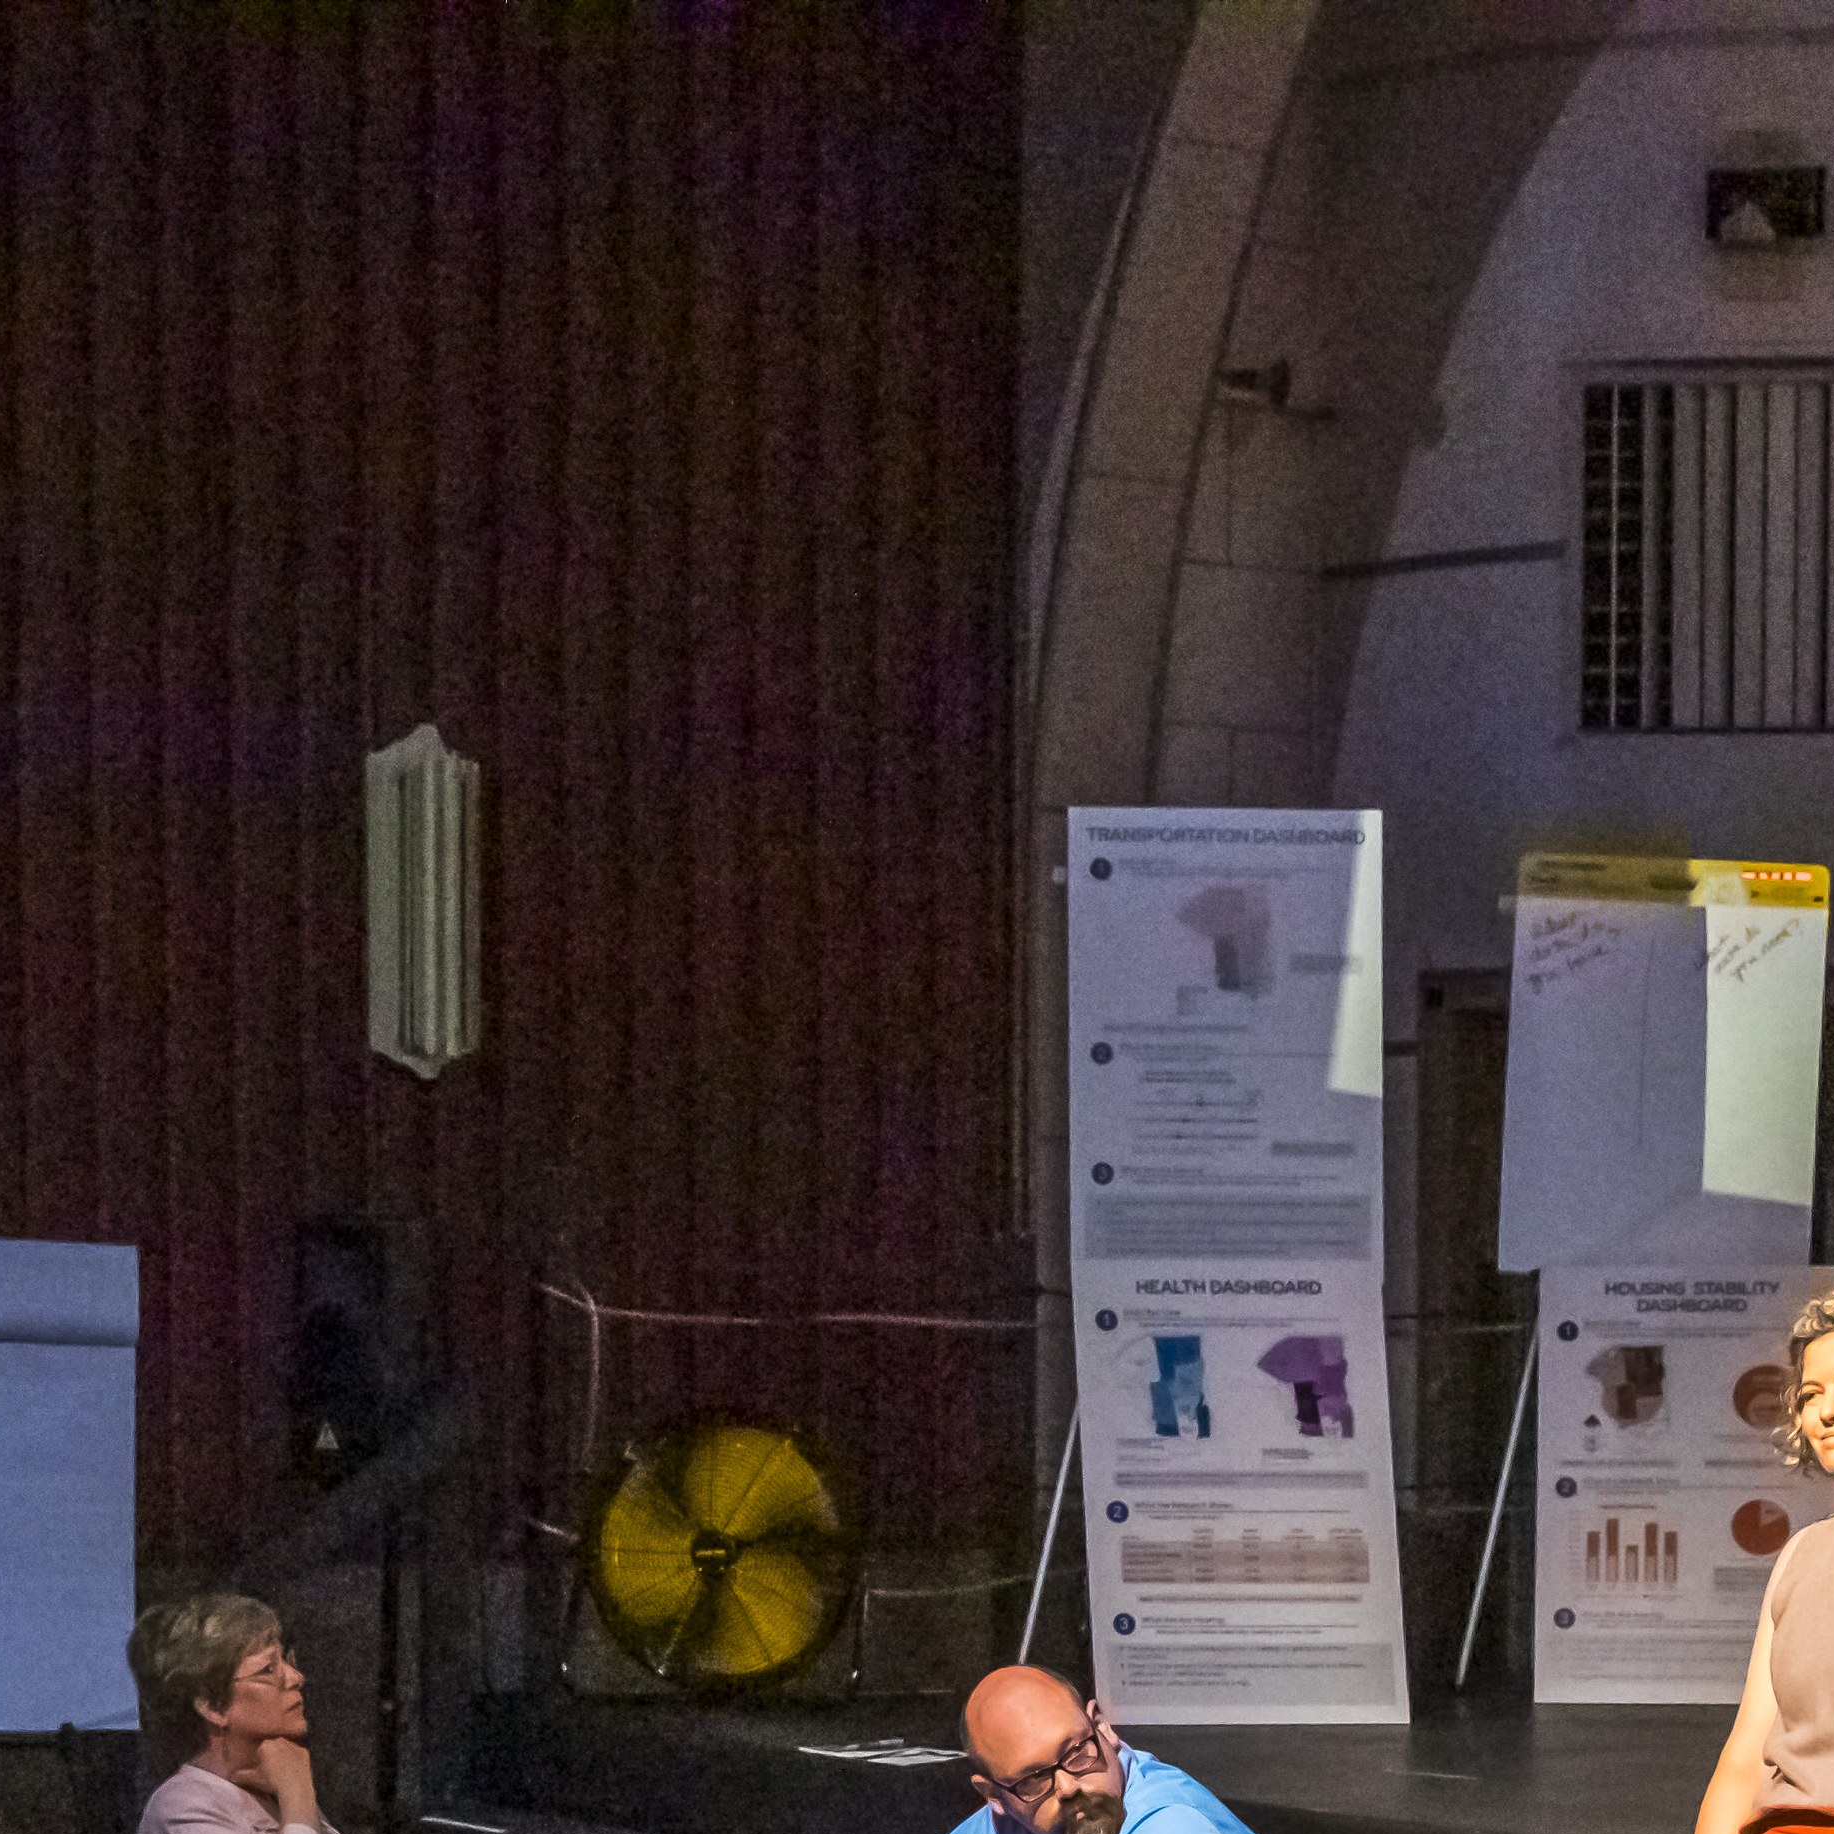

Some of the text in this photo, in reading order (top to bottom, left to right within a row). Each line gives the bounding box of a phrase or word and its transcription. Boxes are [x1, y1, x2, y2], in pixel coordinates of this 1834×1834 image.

[1136, 1280, 1322, 1295] HEALTH DASHBOARD
[1605, 1281, 1780, 1295] HOUSING STABILITY
[1637, 1299, 1748, 1312] DASHBOARD
